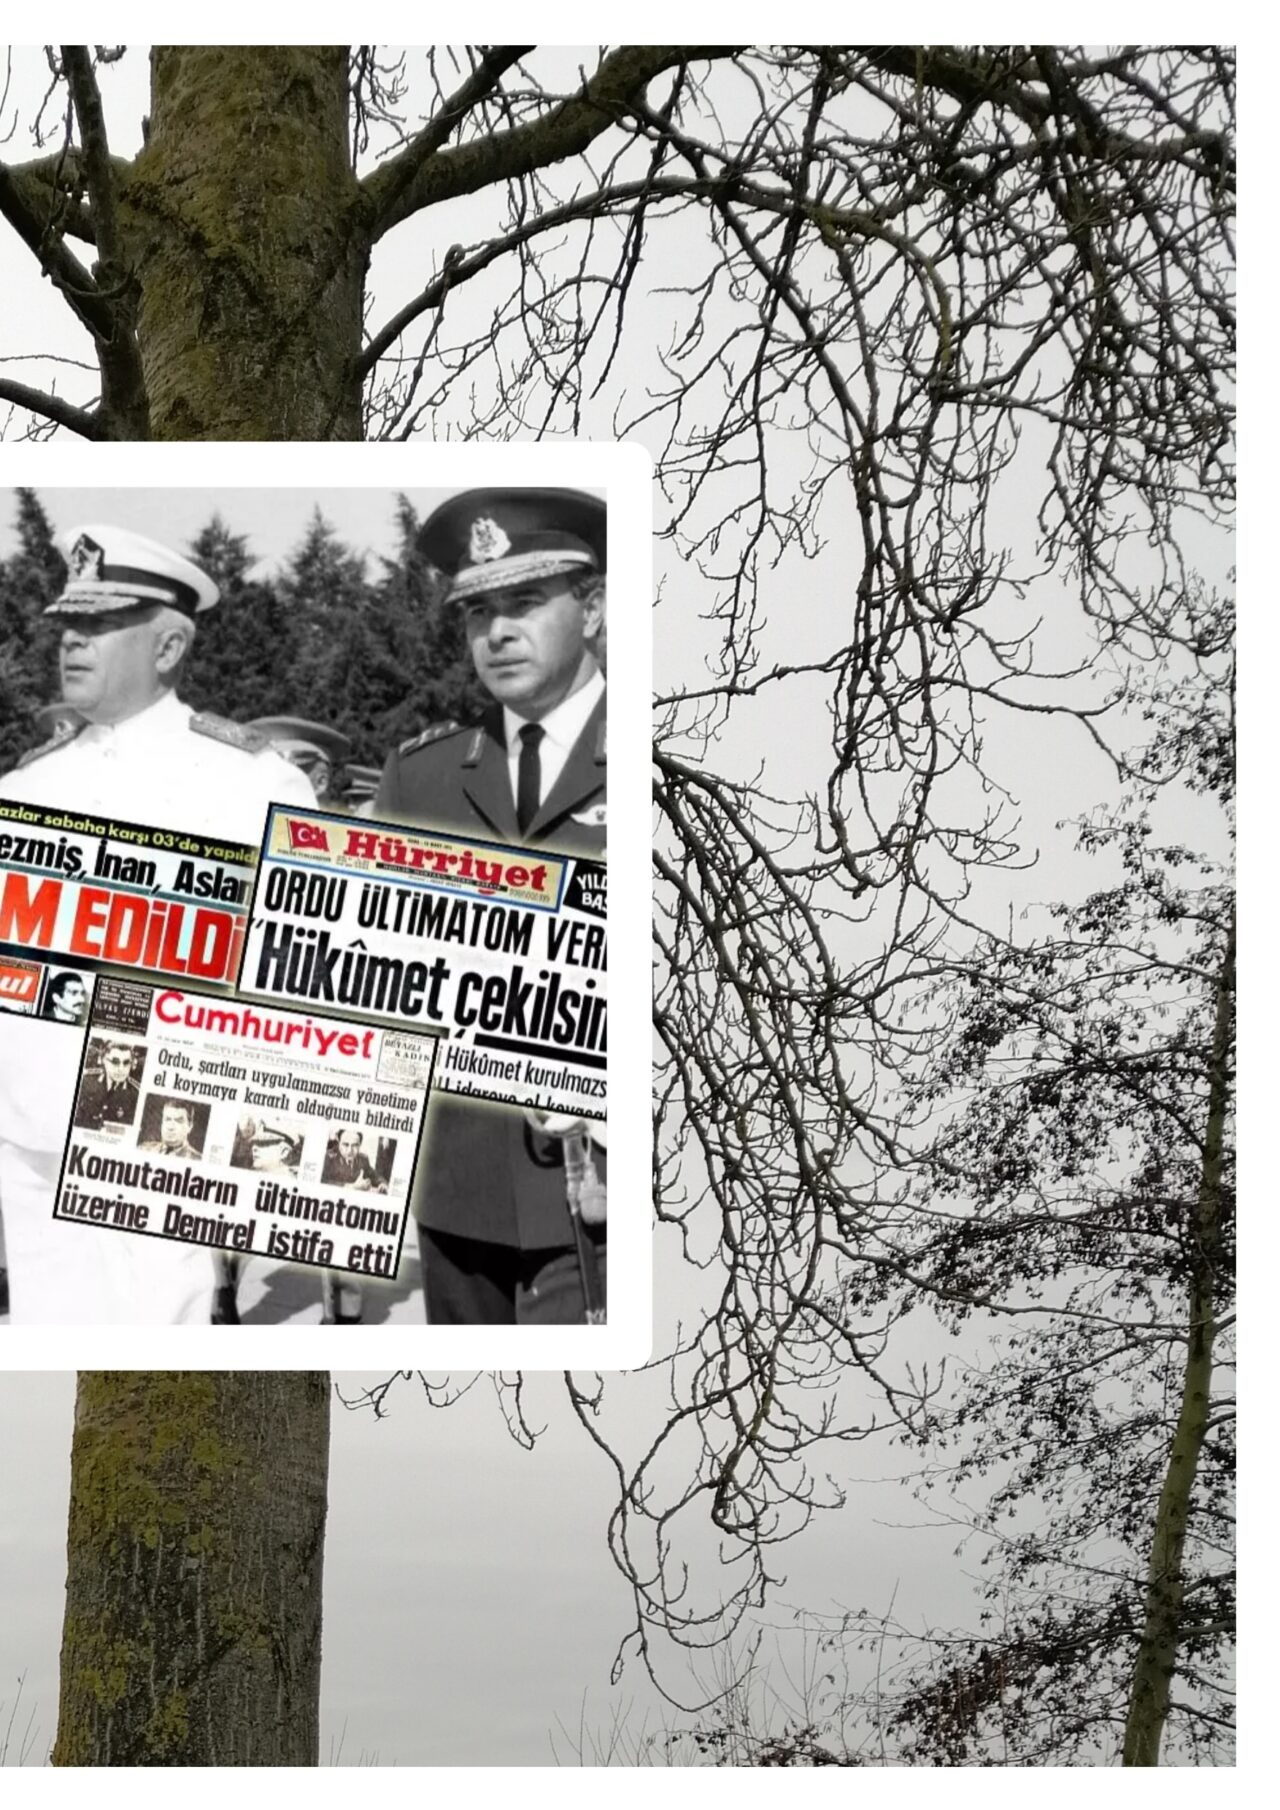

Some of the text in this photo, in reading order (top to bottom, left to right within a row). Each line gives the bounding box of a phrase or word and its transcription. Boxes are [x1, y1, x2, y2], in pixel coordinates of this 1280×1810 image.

[44, 814, 106, 835] sabaha
[109, 823, 149, 844] karşı
[94, 839, 161, 895] İnan,
[344, 830, 548, 896] Hürriyet
[264, 867, 348, 922] ORDU
[547, 917, 607, 972] VER
[155, 989, 375, 1059] Cumhuriyet
[158, 1049, 193, 1071] Ordu,
[199, 1059, 247, 1080] şartları
[252, 1070, 351, 1099] uygulanmazsa
[357, 1088, 418, 1112] yönetime
[445, 1045, 522, 1082] Hükûmet
[154, 1071, 414, 1133] el koymaya kararlı olduğunu bildirdi
[68, 1144, 400, 1236] Komutanların ültimatomu
[61, 1183, 394, 1275] üzerine Demirel istifa etti
